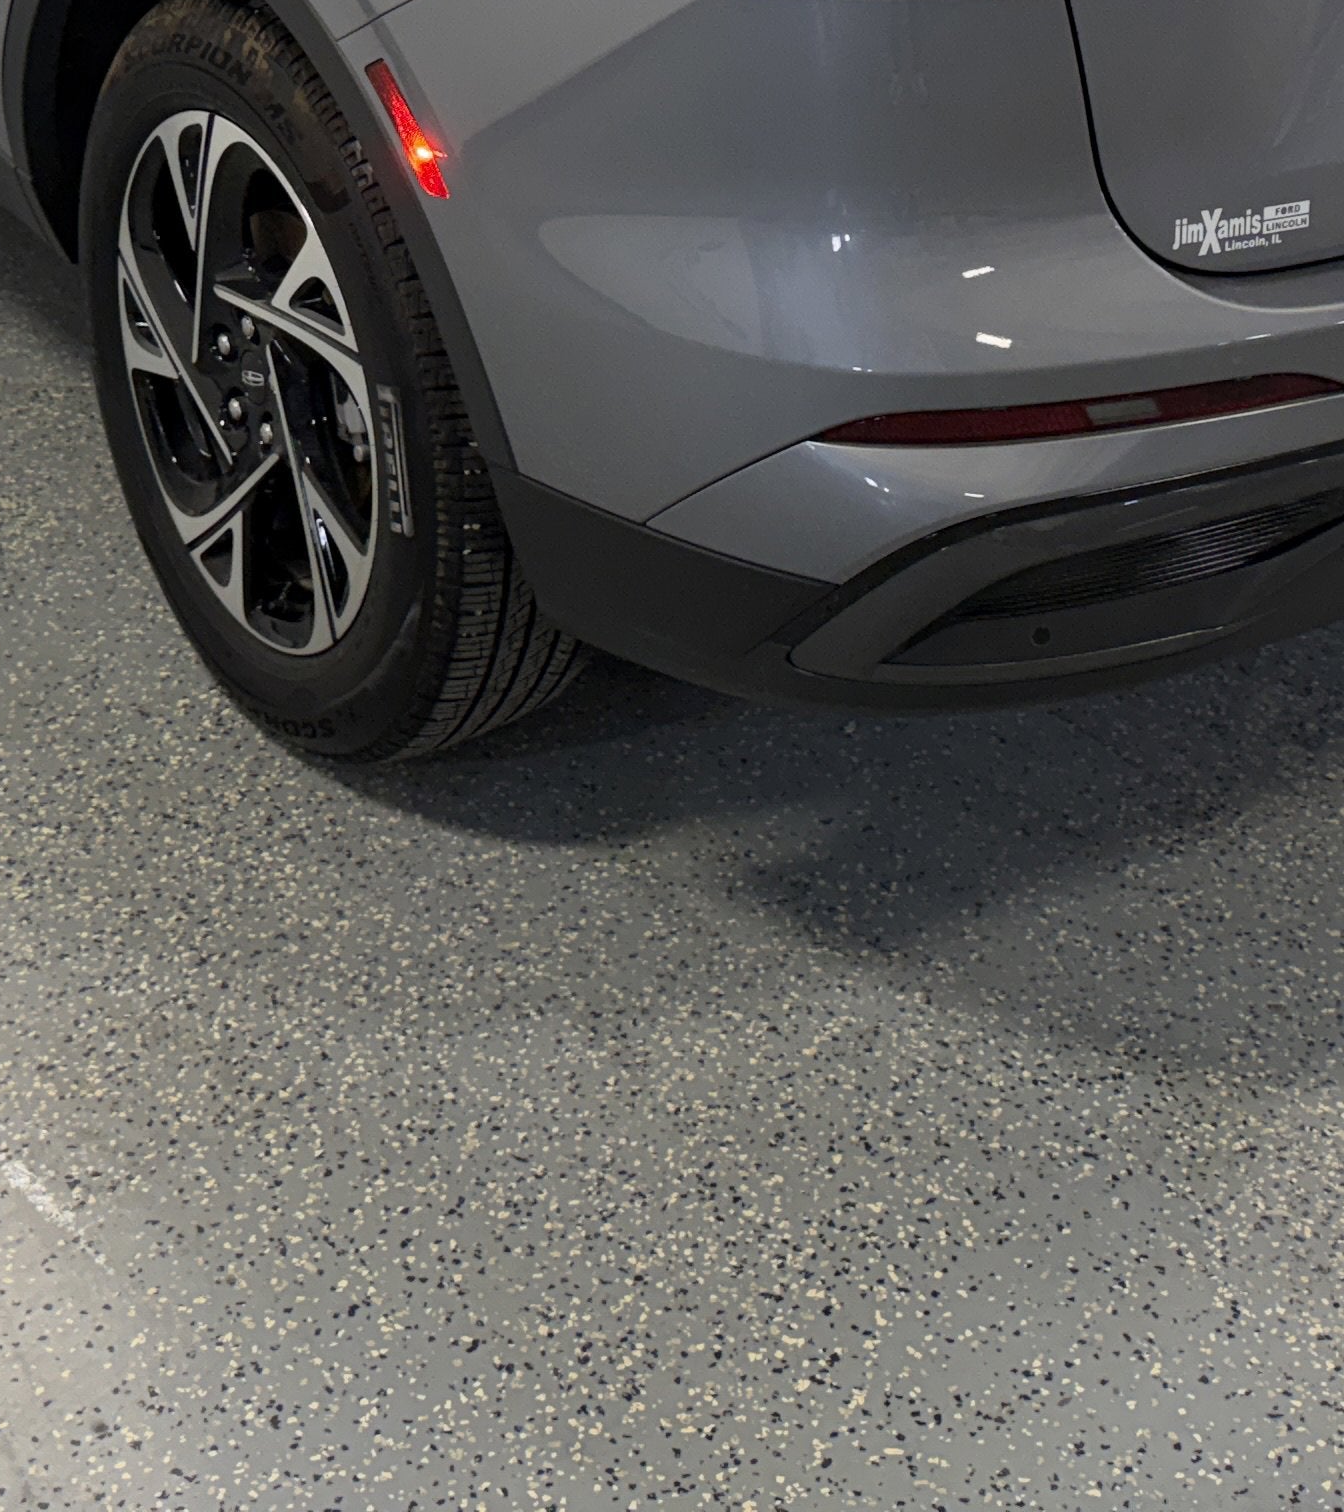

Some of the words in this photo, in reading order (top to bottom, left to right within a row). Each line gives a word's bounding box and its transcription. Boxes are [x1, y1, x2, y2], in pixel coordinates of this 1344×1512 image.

[1275, 204, 1301, 216] FORD
[1265, 218, 1307, 232] LINCOLN
[1224, 236, 1269, 252] Lincoln,
[1271, 234, 1283, 245] IL
